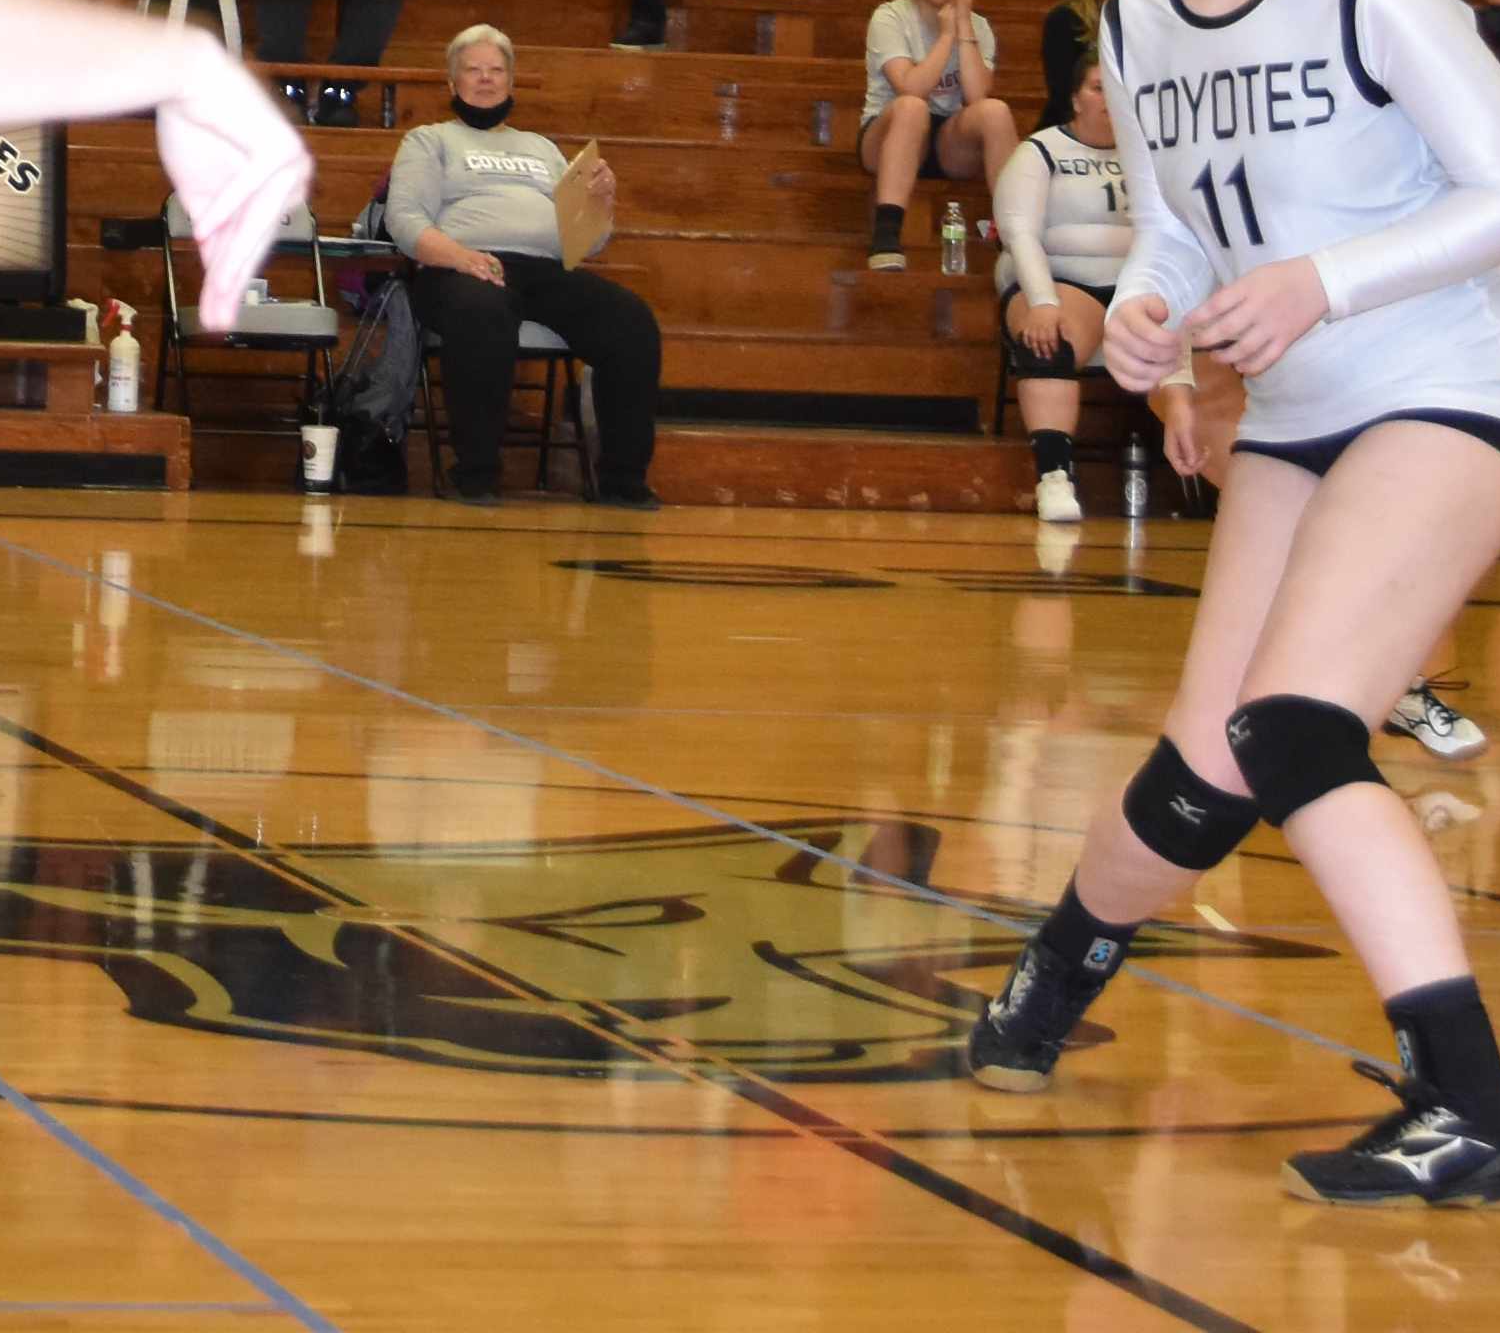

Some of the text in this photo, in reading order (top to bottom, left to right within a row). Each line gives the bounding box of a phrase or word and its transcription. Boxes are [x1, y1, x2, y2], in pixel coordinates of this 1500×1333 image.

[1134, 57, 1336, 153] COYOTES
[466, 154, 550, 177] COYOTES
[1190, 154, 1265, 250] 11
